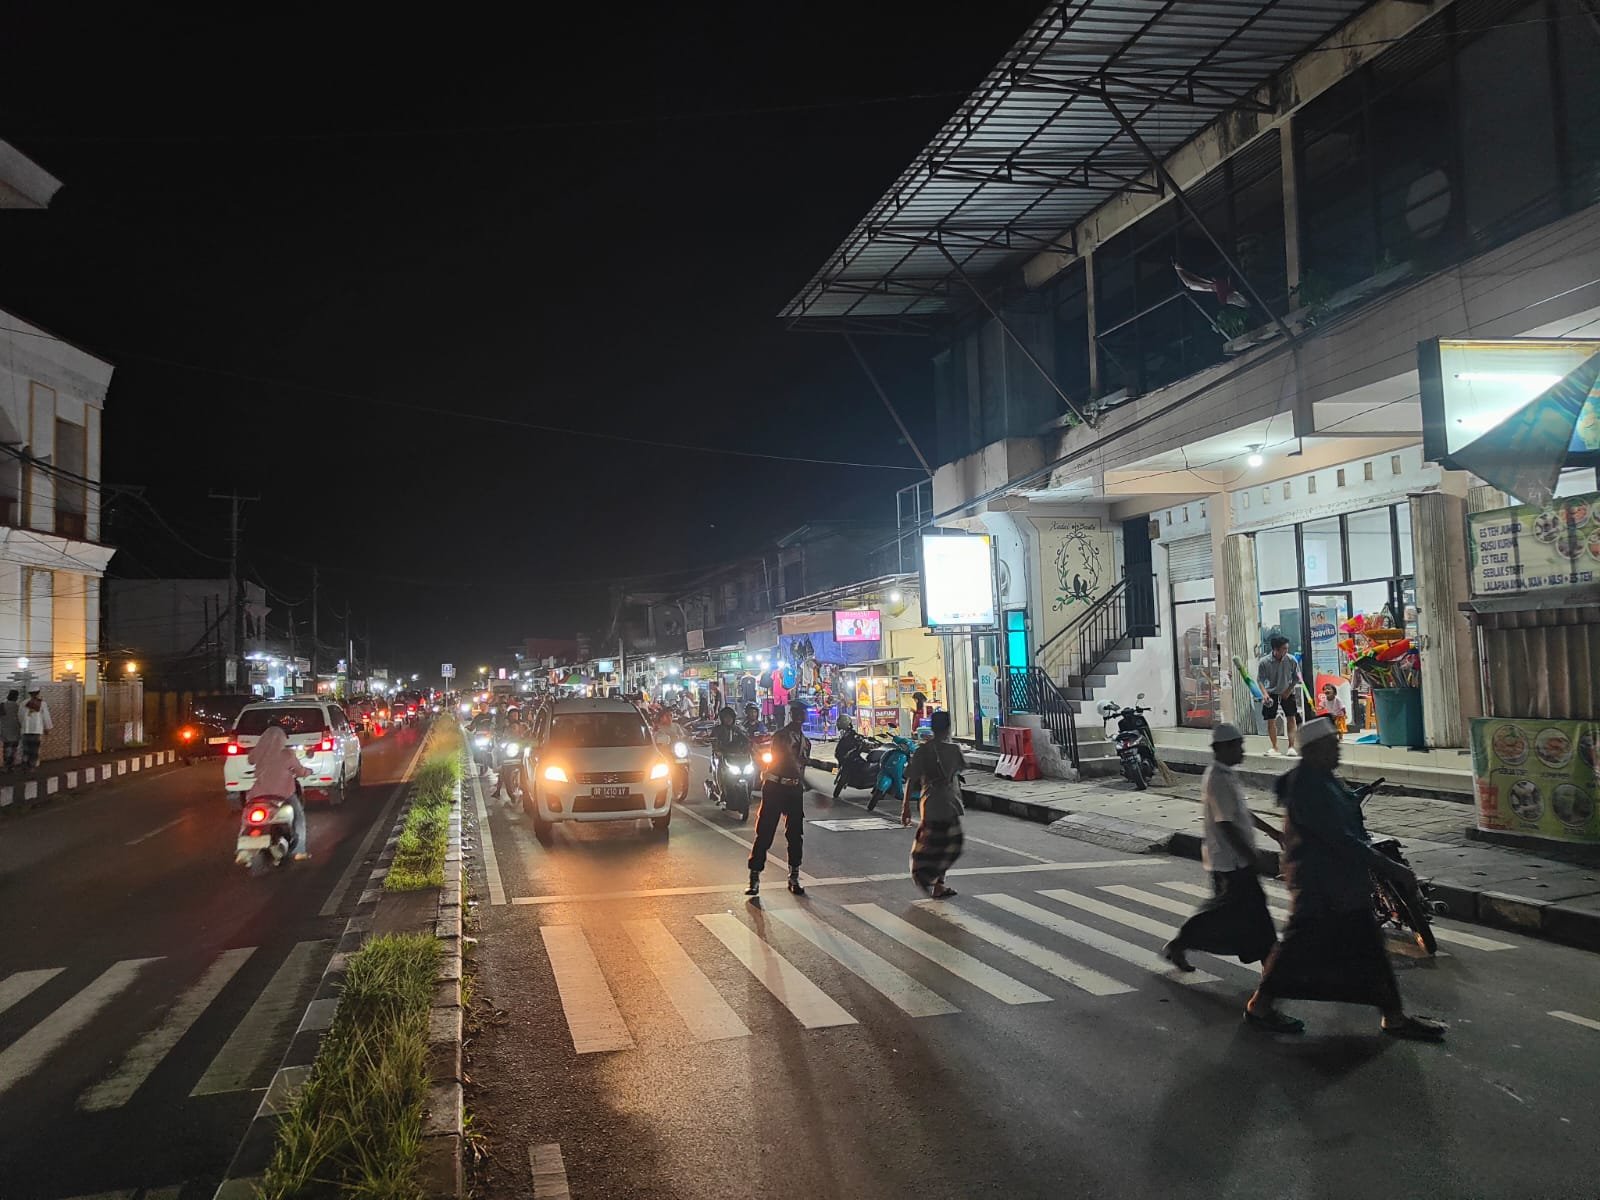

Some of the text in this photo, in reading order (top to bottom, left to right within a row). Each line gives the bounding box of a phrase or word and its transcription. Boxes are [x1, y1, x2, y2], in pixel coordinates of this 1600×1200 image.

[1480, 528, 1488, 538] ES
[1488, 525, 1499, 537] TEH
[1480, 540, 1497, 552] SUSU
[1482, 553, 1508, 565] ES TELER
[1483, 566, 1505, 578] SEBLAK
[1579, 571, 1593, 582] TEH
[981, 674, 991, 685] BSI
